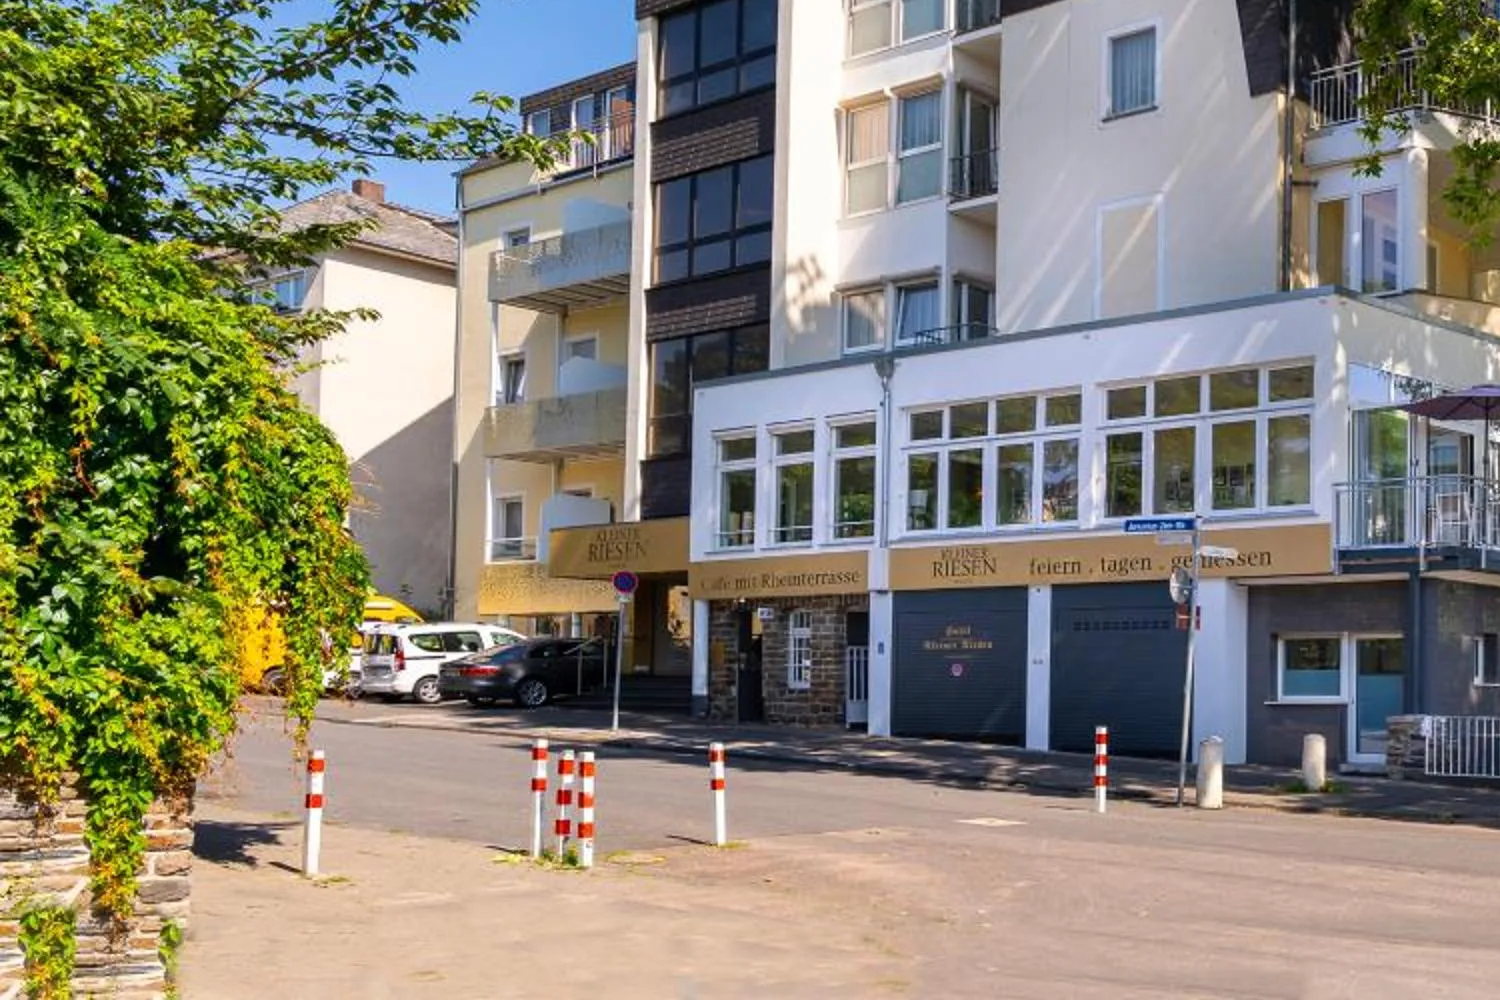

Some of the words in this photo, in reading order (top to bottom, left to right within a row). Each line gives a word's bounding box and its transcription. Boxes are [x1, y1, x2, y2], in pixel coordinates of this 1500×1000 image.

[932, 557, 997, 578] RIESEN
[1029, 557, 1081, 576] feiern
[1101, 555, 1152, 575] tagen
[761, 568, 861, 589] Rheinterrasse
